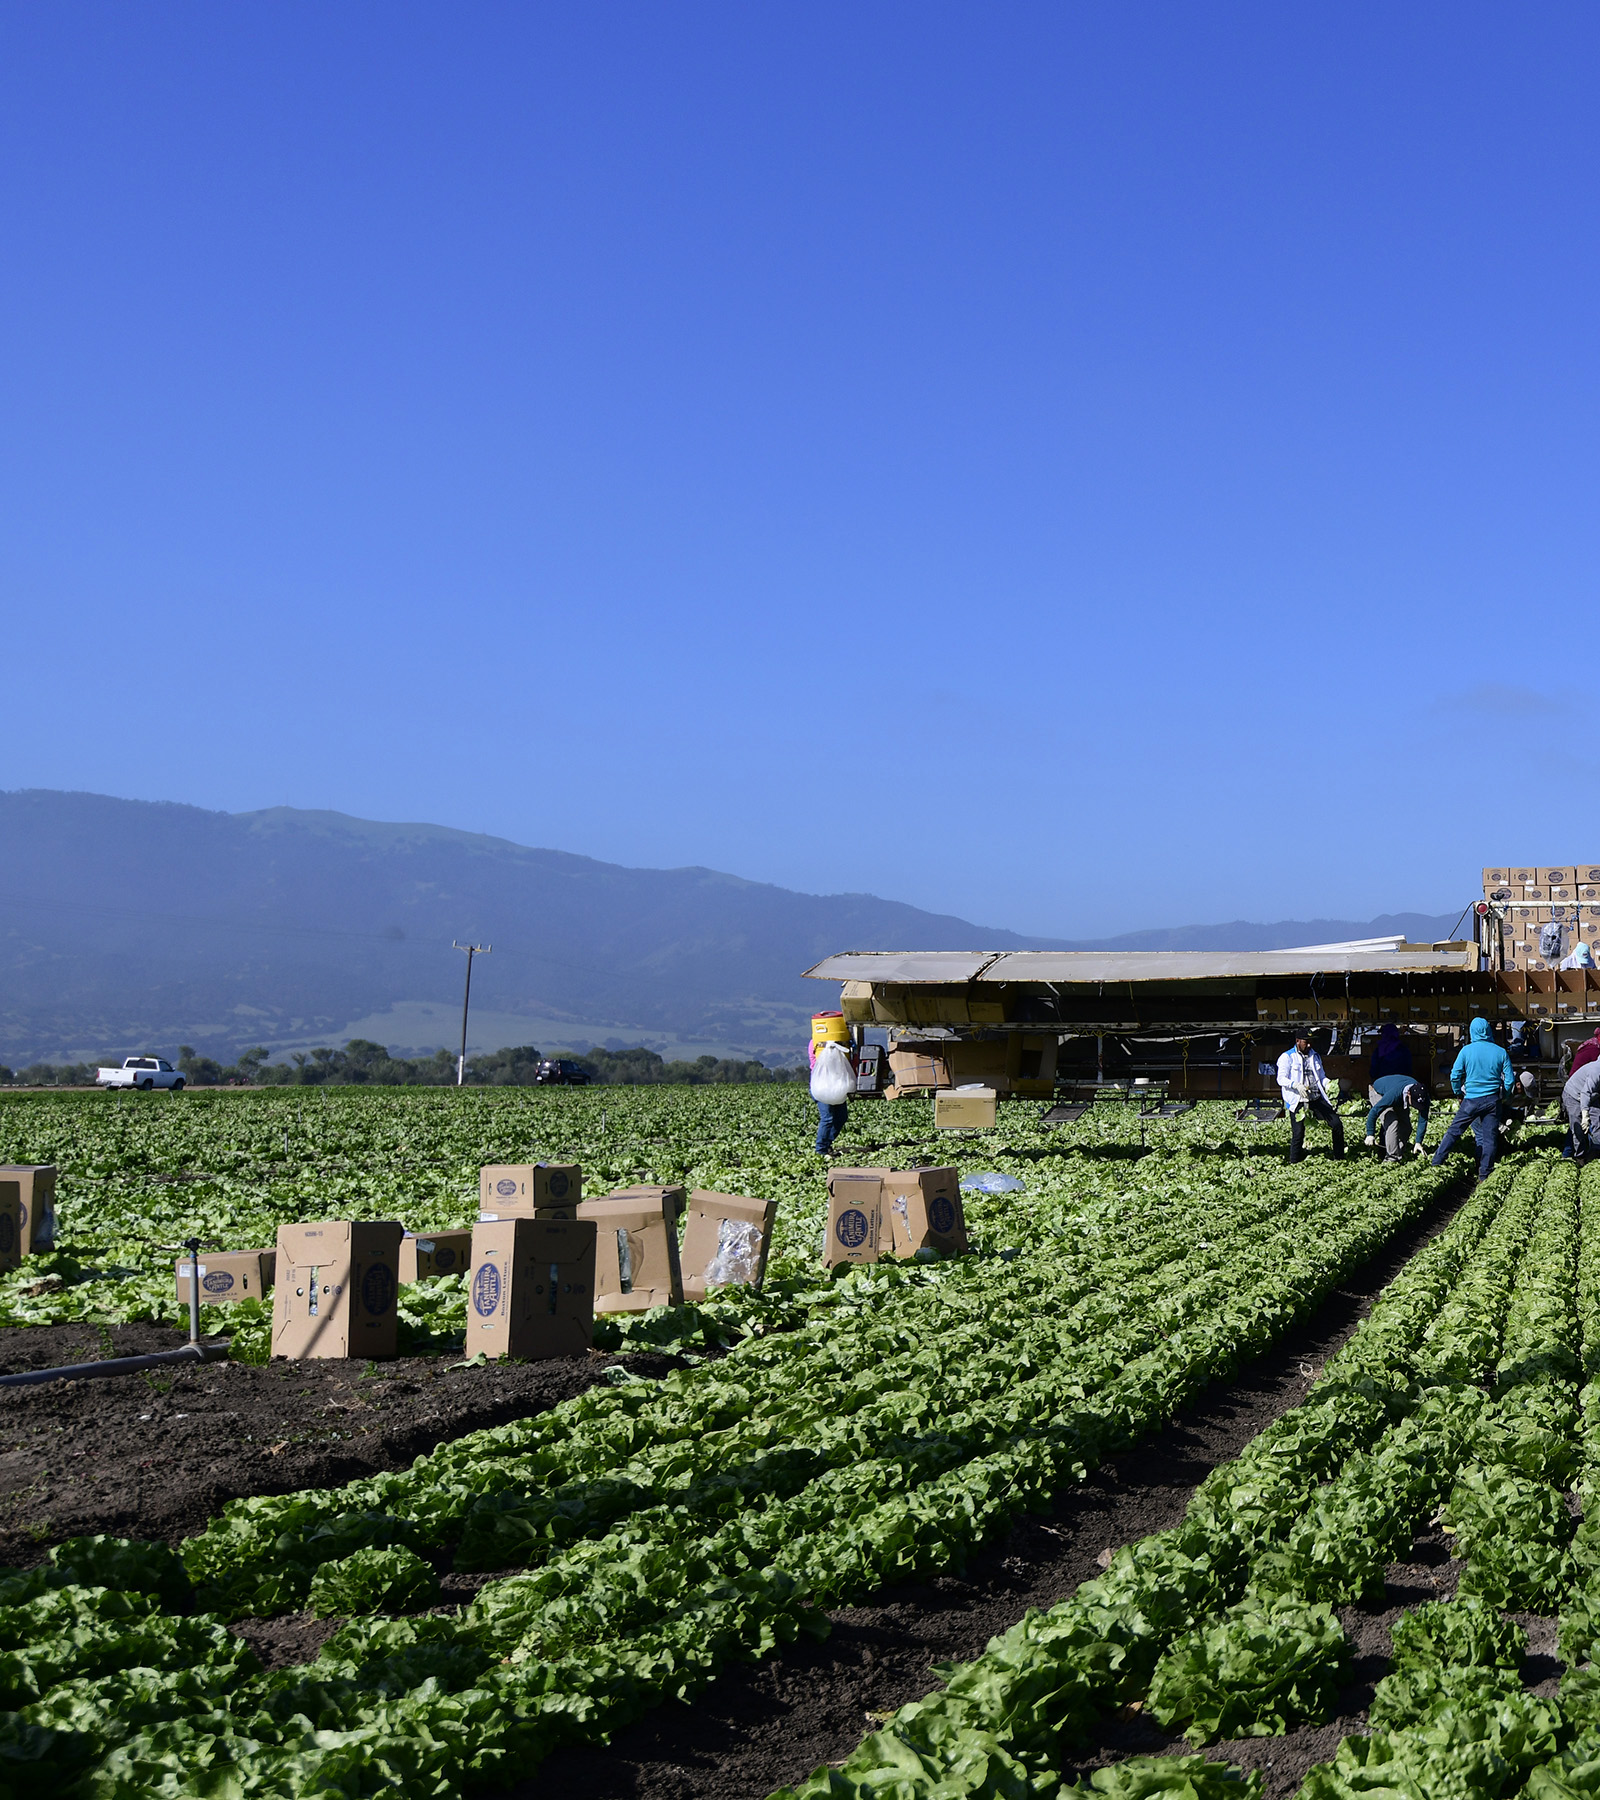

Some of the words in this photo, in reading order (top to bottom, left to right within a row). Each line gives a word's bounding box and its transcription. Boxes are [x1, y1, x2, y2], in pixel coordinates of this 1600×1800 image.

[847, 1211, 858, 1247] TANIMURA
[855, 1216, 864, 1240] ANTLE
[482, 1265, 492, 1316] TANIMURA
[489, 1272, 498, 1303] ANTLE
